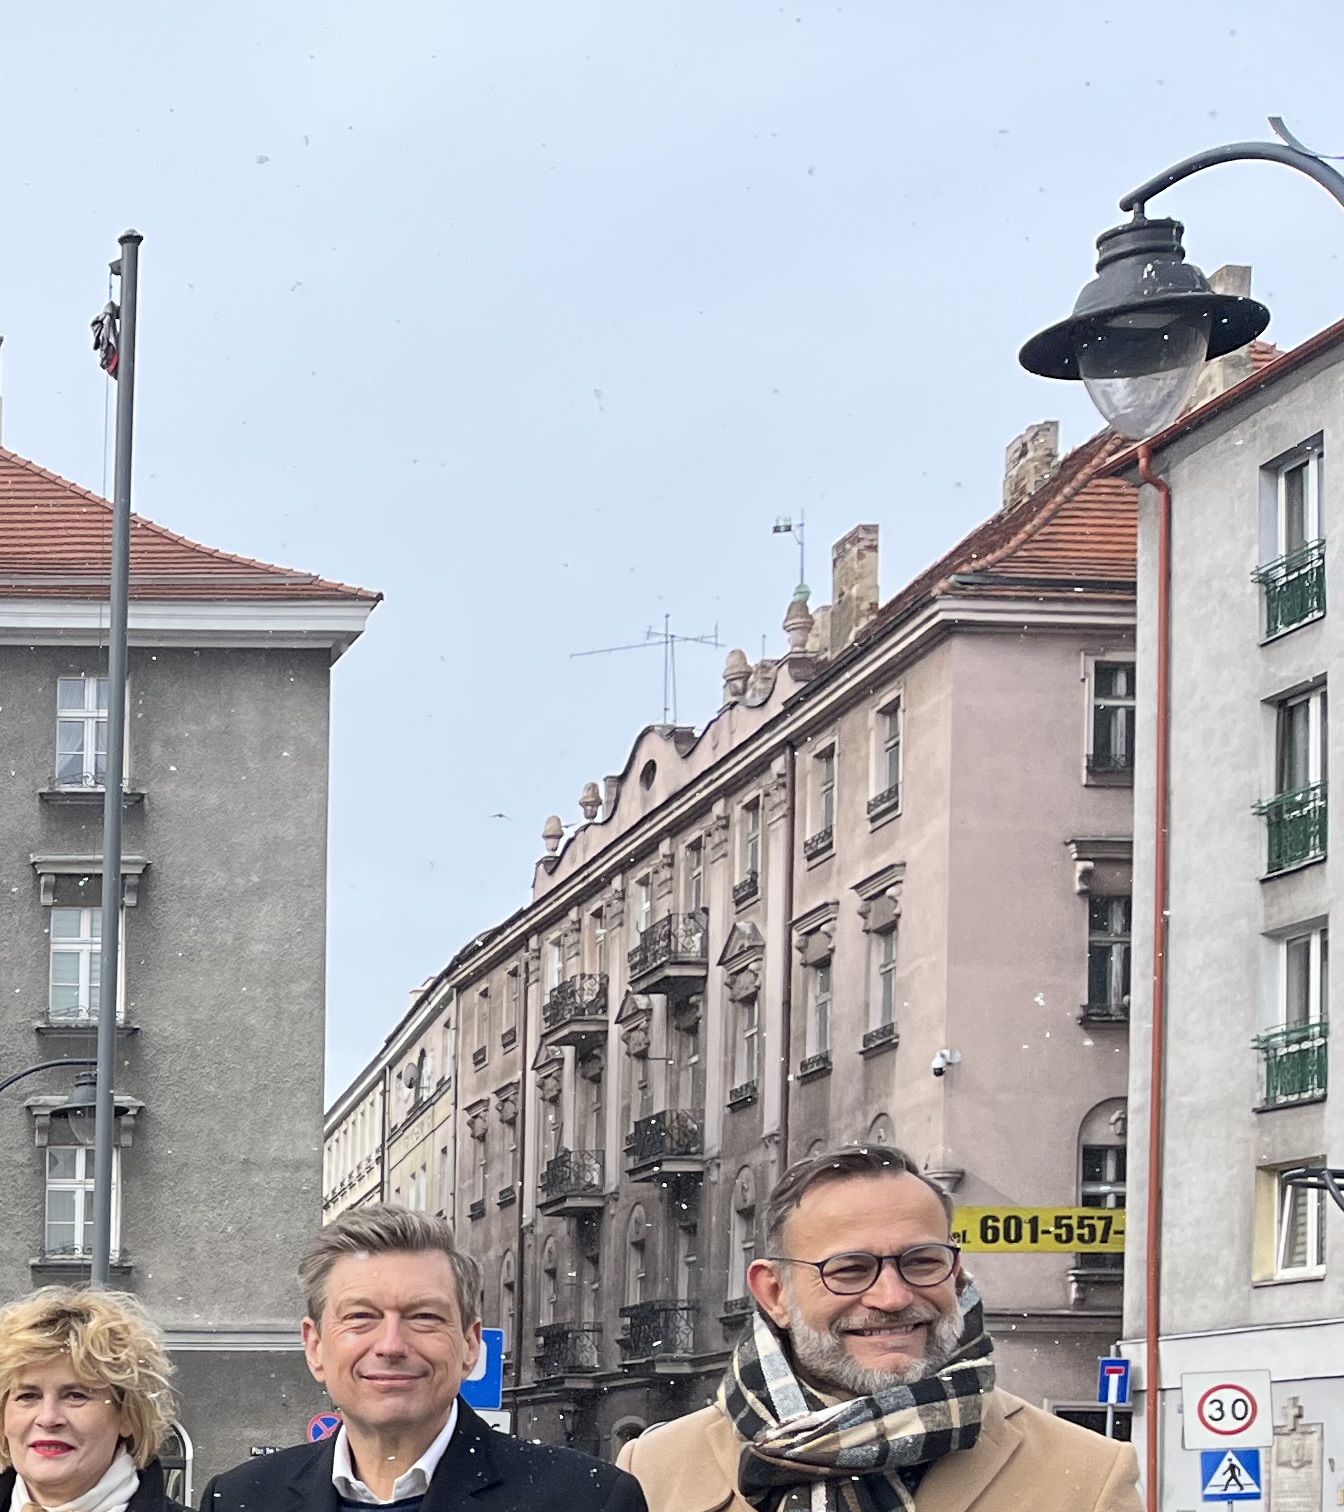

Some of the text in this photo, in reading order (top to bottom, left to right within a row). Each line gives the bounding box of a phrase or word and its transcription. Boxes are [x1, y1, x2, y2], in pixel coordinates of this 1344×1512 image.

[951, 1214, 1125, 1244] el. 601-557-
[1208, 1398, 1249, 1422] 30
